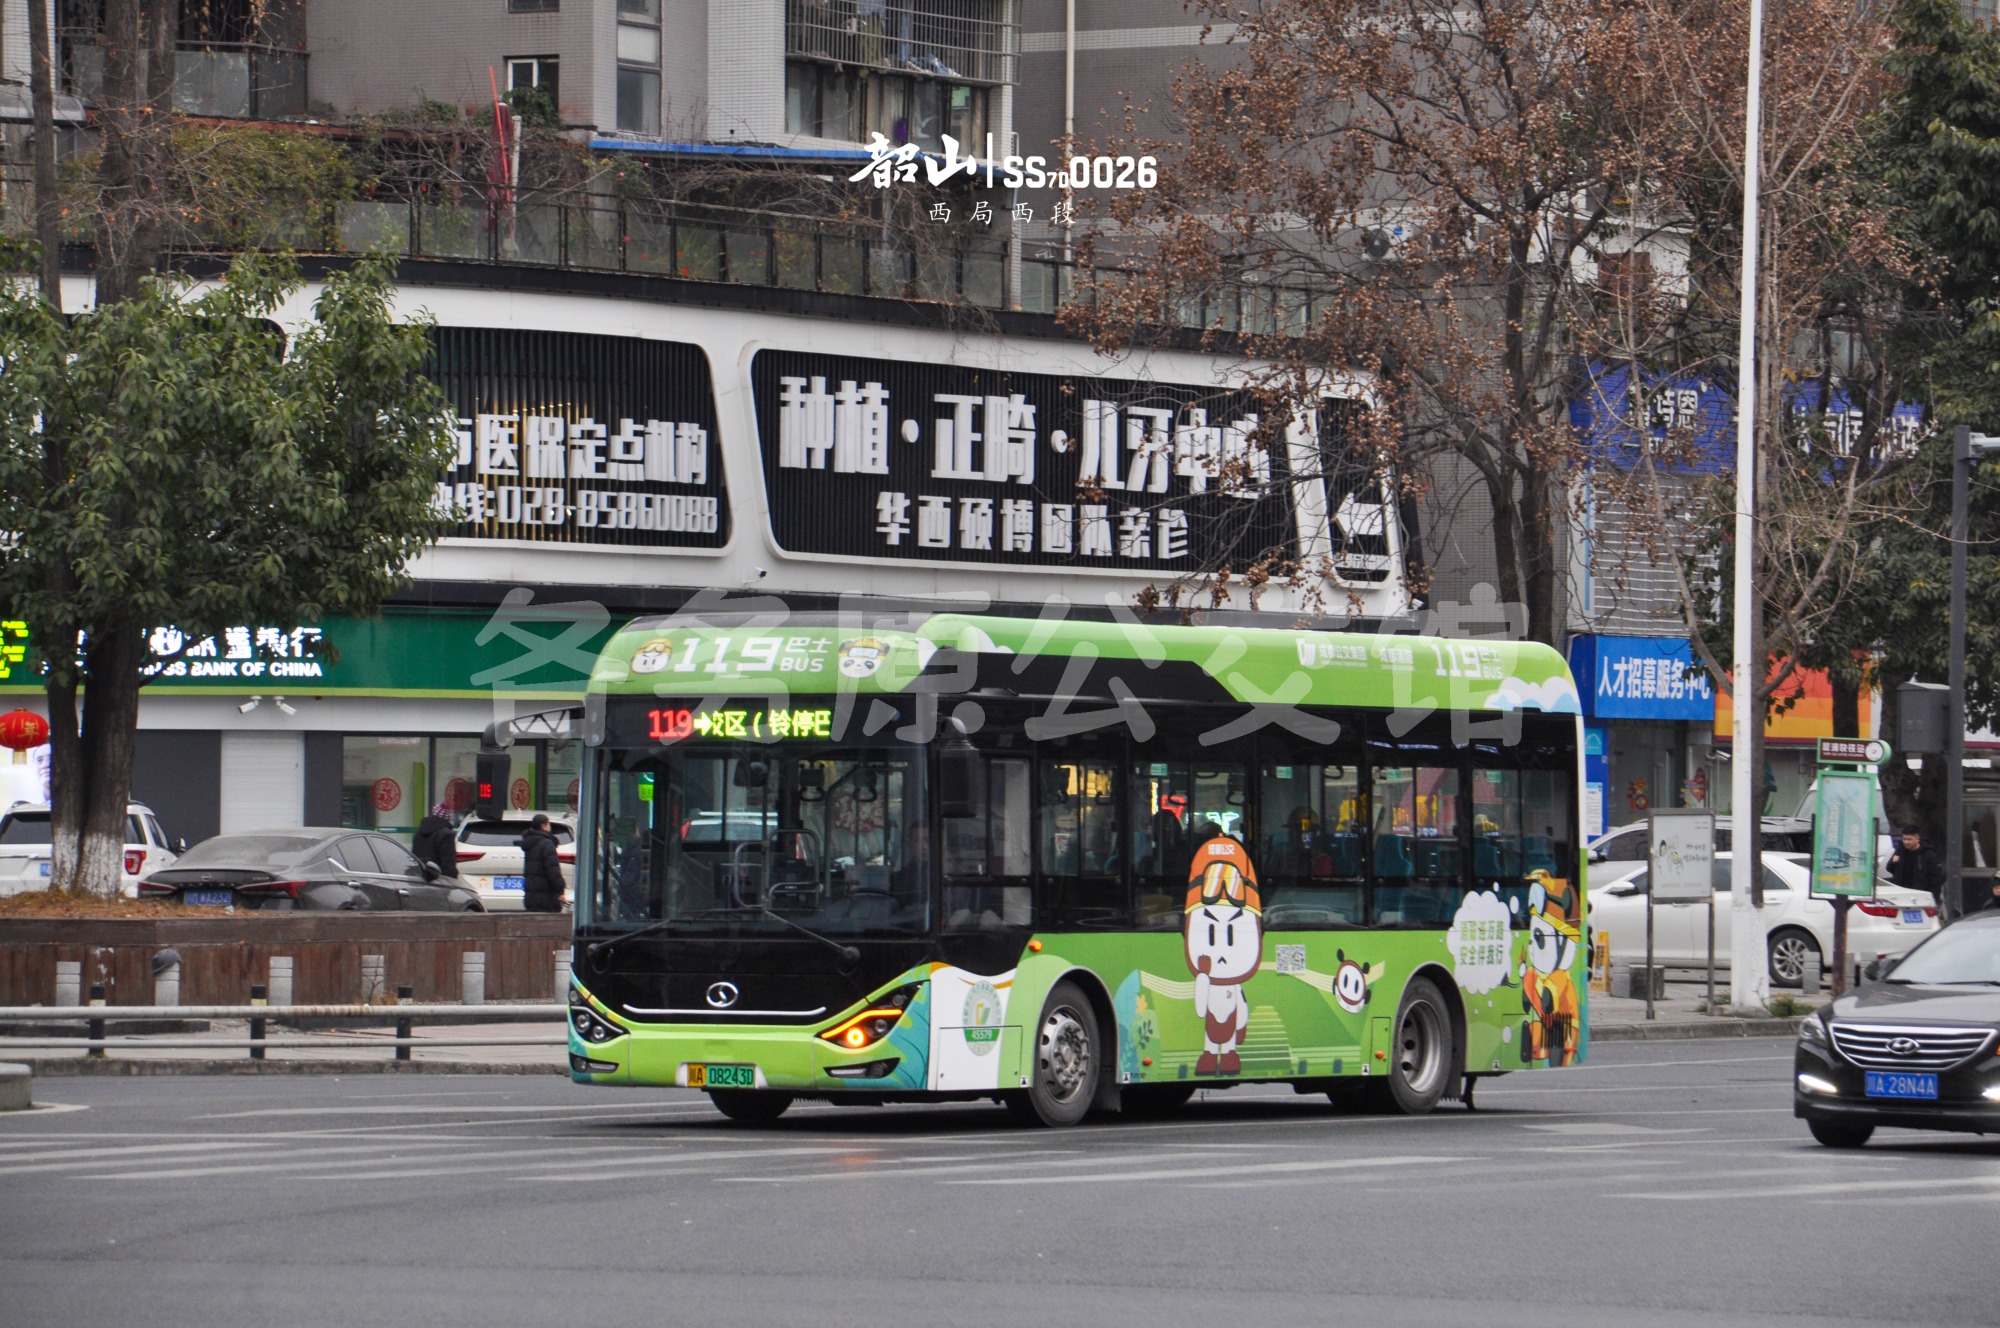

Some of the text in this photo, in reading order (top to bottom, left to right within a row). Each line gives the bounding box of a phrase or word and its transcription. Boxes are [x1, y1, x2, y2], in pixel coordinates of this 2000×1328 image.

[875, 491, 1189, 559] 华西硕博团队亲诊
[190, 661, 239, 678] BANK
[241, 661, 266, 678] OF
[269, 661, 323, 678] CHINA
[674, 636, 833, 673] 119 巴士
[780, 657, 825, 673] BUS
[1434, 643, 1483, 677] 119
[1480, 645, 1501, 662] 巴士
[1482, 666, 1504, 680] BUS
[1598, 655, 1711, 701] 人才招募服务中心
[648, 709, 692, 738] 119
